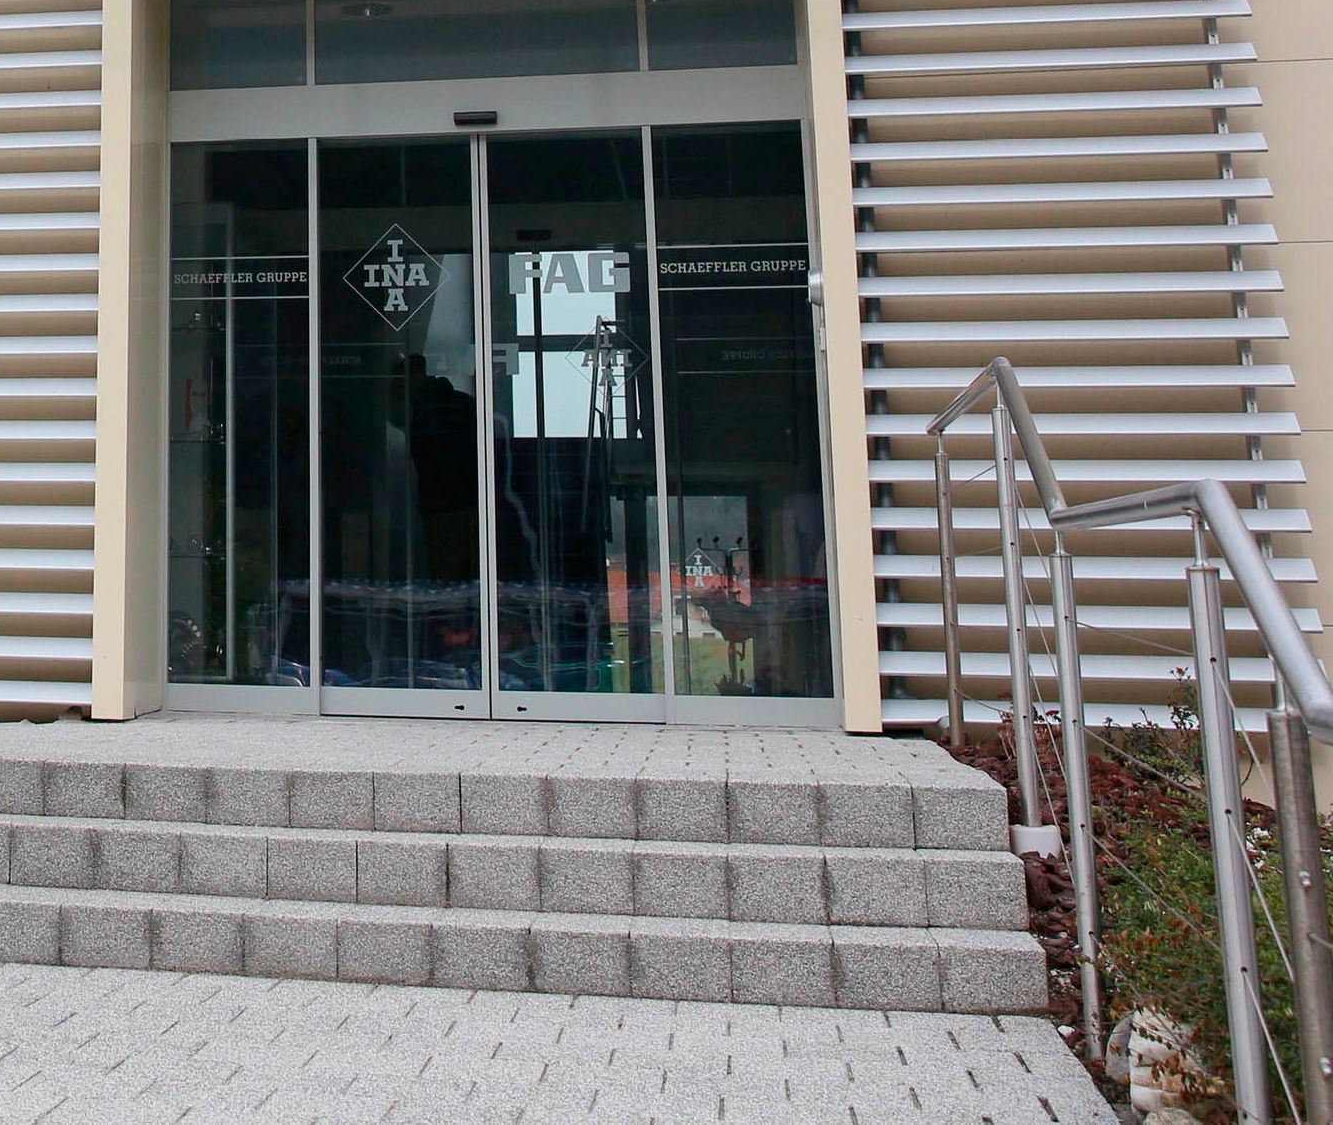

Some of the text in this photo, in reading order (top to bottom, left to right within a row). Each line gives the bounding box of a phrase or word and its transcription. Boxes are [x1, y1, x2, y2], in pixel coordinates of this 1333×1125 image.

[363, 263, 430, 287] INA
[508, 251, 631, 294] FAG
[659, 259, 806, 274] SCHAEFFLER GRUPPE
[173, 271, 307, 284] SCHAEFFLER GRUPPE
